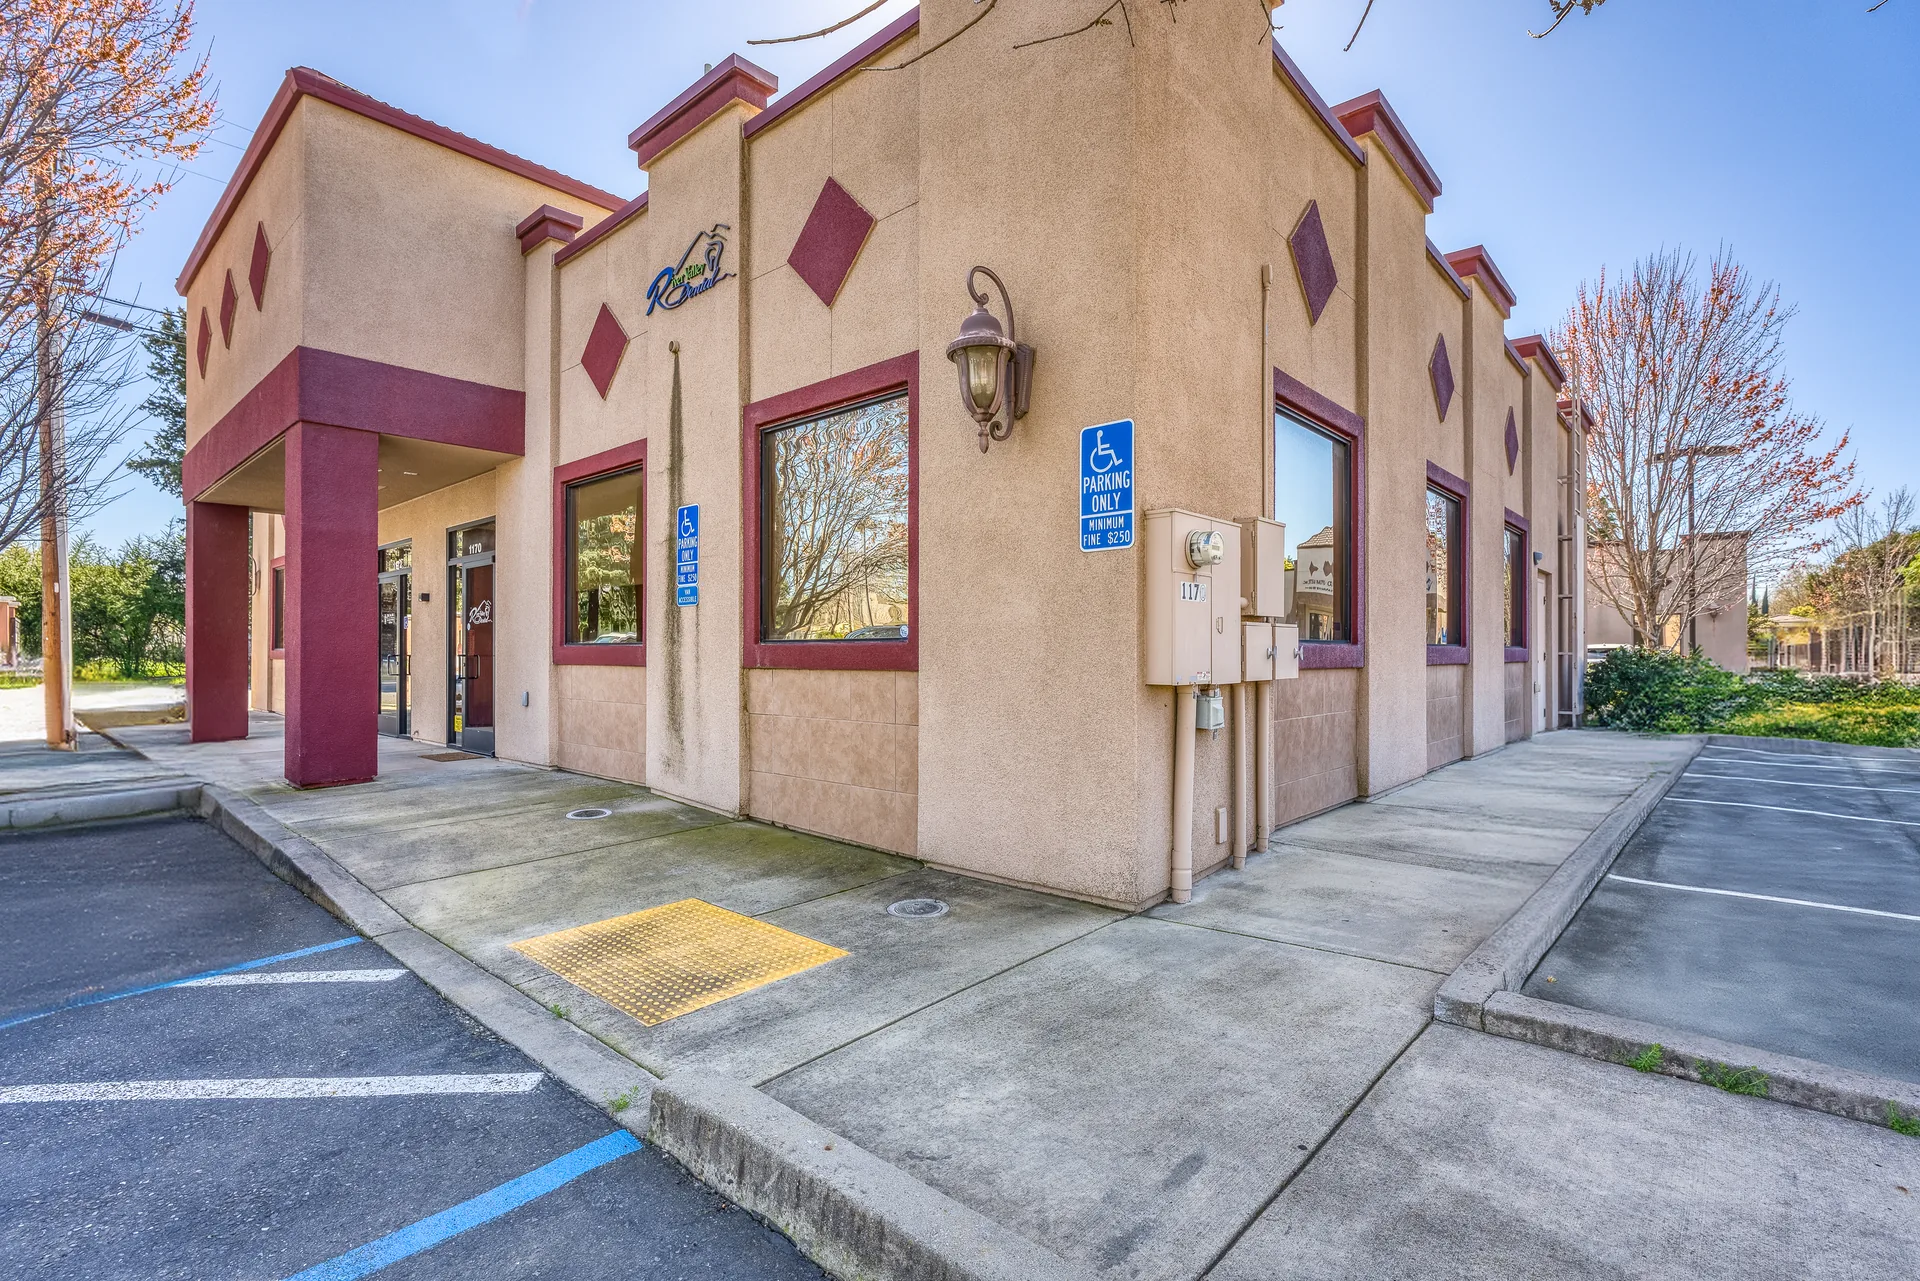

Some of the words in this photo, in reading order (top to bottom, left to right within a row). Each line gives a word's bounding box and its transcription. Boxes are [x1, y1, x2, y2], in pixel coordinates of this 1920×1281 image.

[685, 263, 706, 280] Valley
[1083, 470, 1130, 494] PARKING
[1091, 492, 1121, 513] ONLY
[1089, 515, 1125, 531] MINIMUM
[678, 536, 697, 549] PARKING
[1083, 532, 1101, 547] FINE
[1107, 529, 1130, 546] $250
[468, 542, 482, 555] 1170
[682, 550, 694, 561] ONLY
